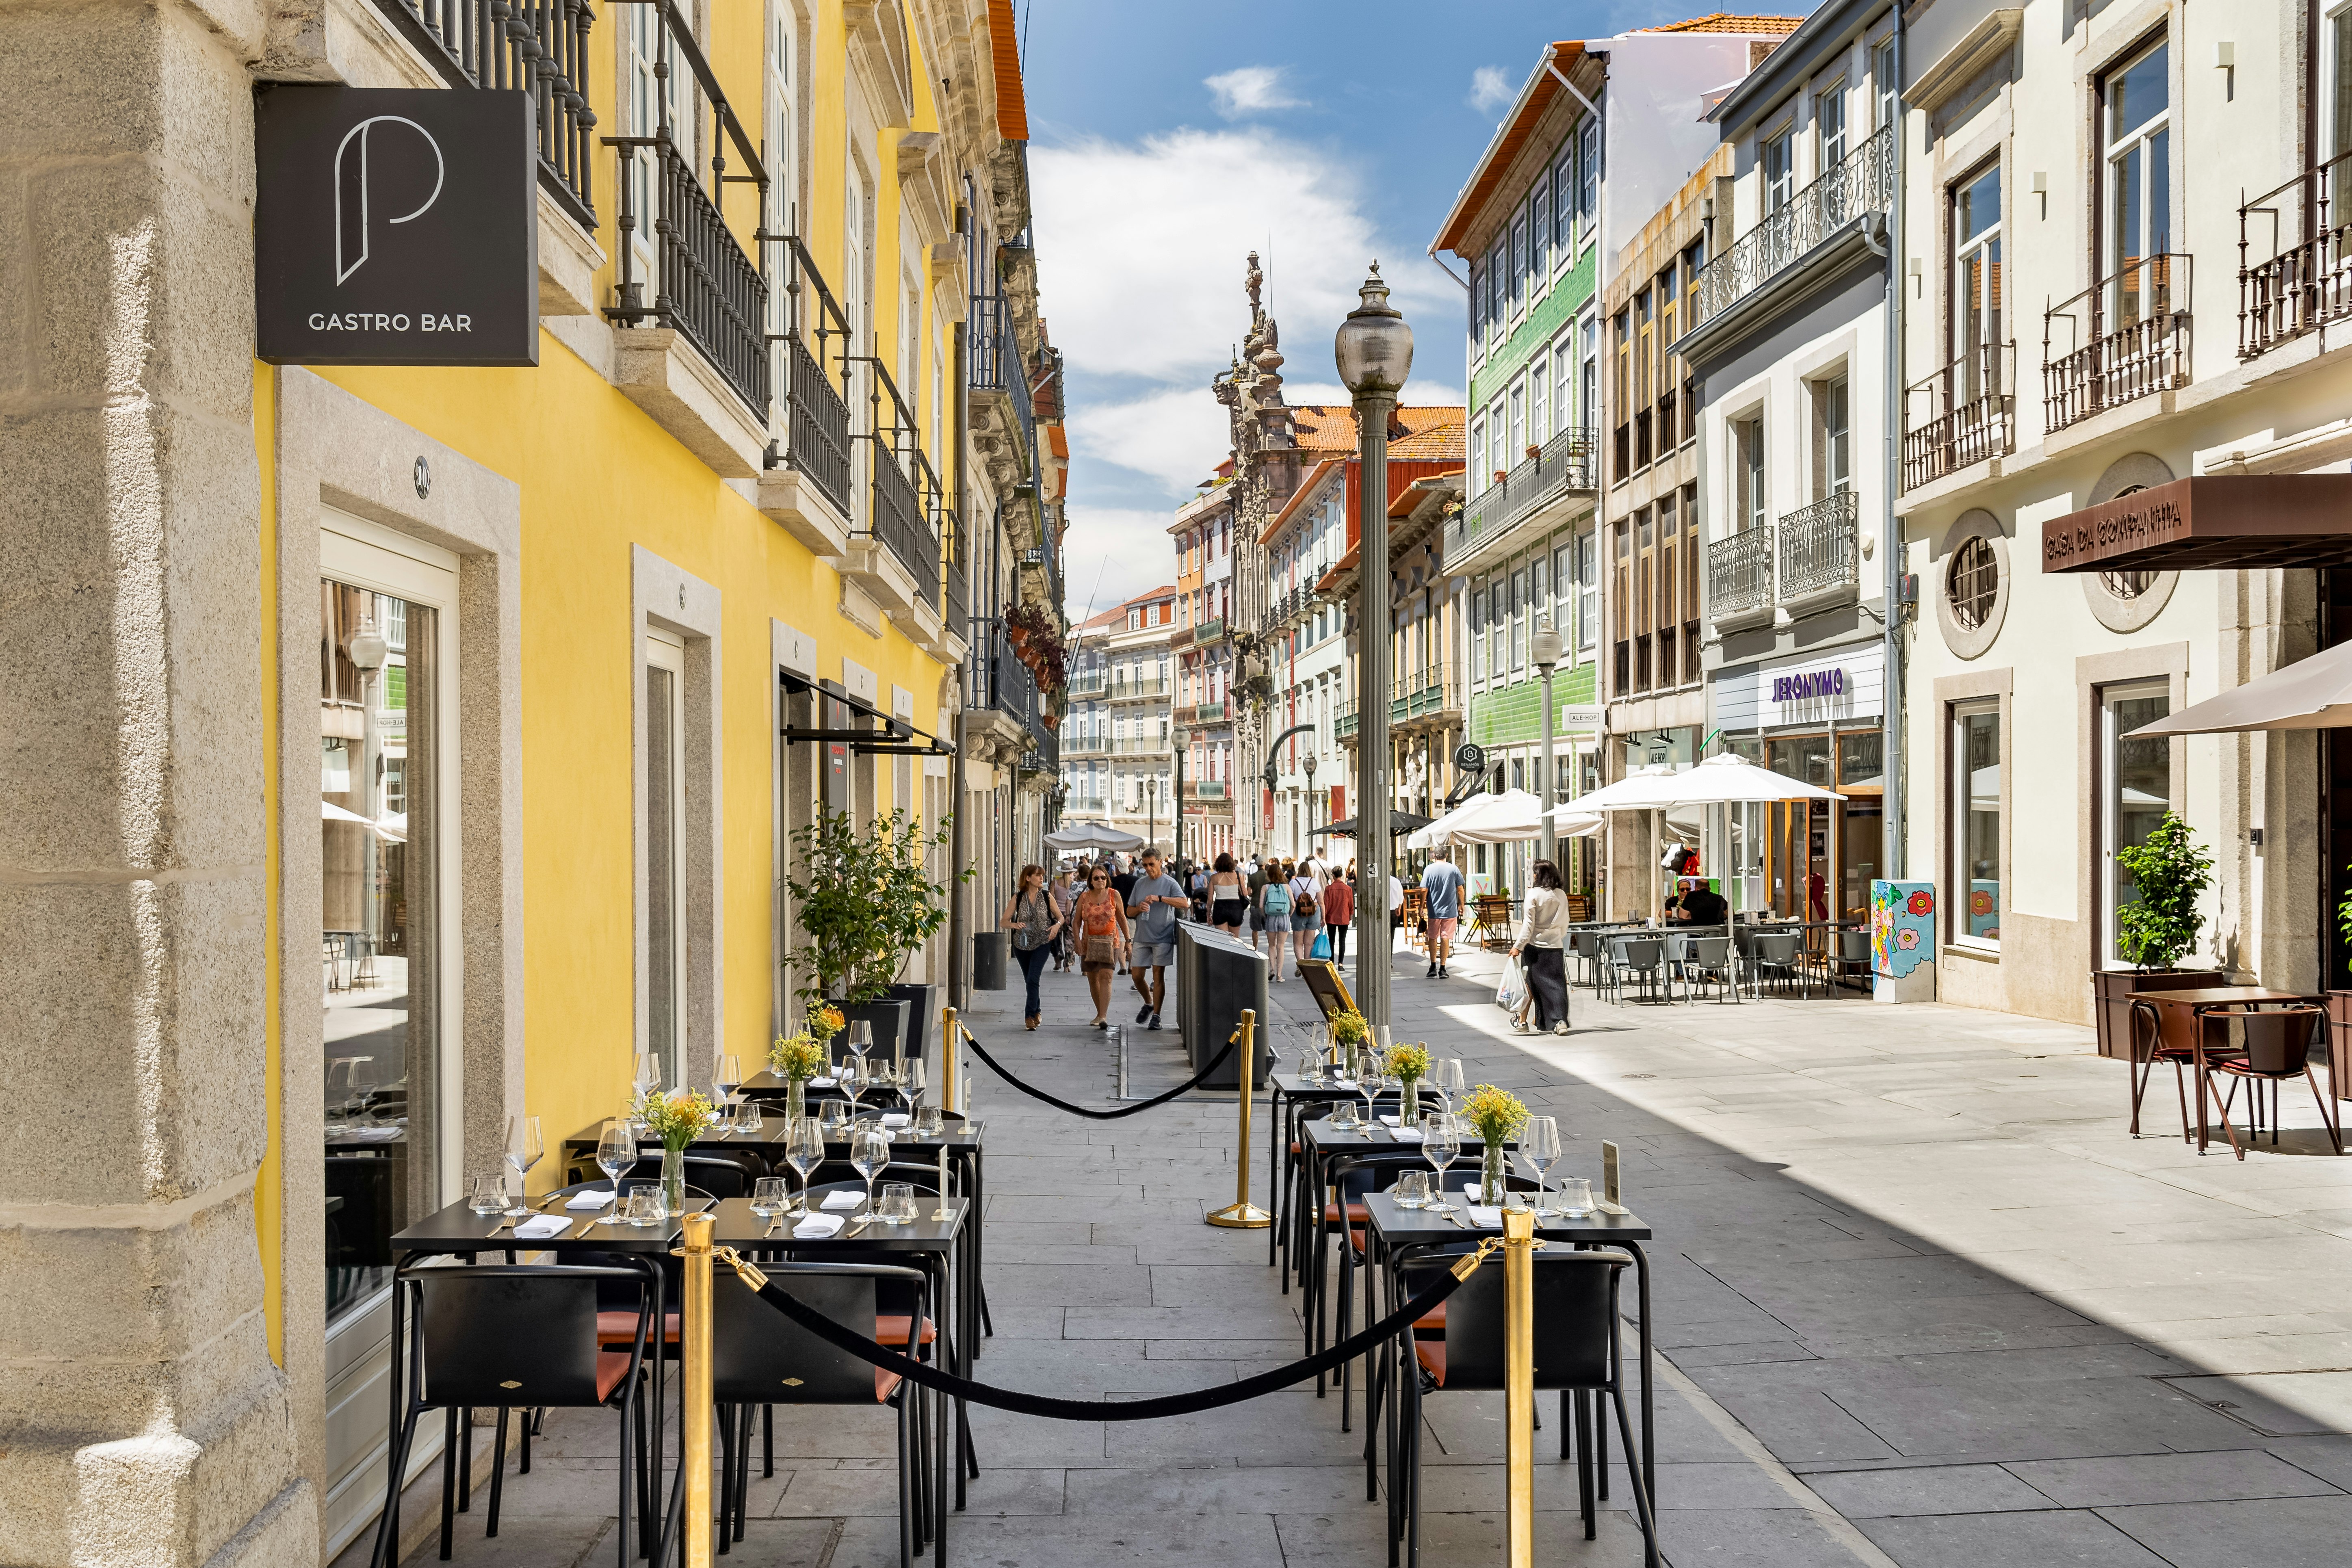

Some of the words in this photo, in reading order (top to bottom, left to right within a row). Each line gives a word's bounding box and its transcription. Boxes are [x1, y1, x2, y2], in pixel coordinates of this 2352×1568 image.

[335, 115, 444, 287] P
[309, 313, 410, 332] GASTRO
[421, 314, 472, 332] BAR
[2046, 531, 2074, 559] CASA
[2077, 525, 2094, 552] DA
[2097, 499, 2181, 546] COMPANHIA
[1772, 667, 1843, 703] JERONYMO
